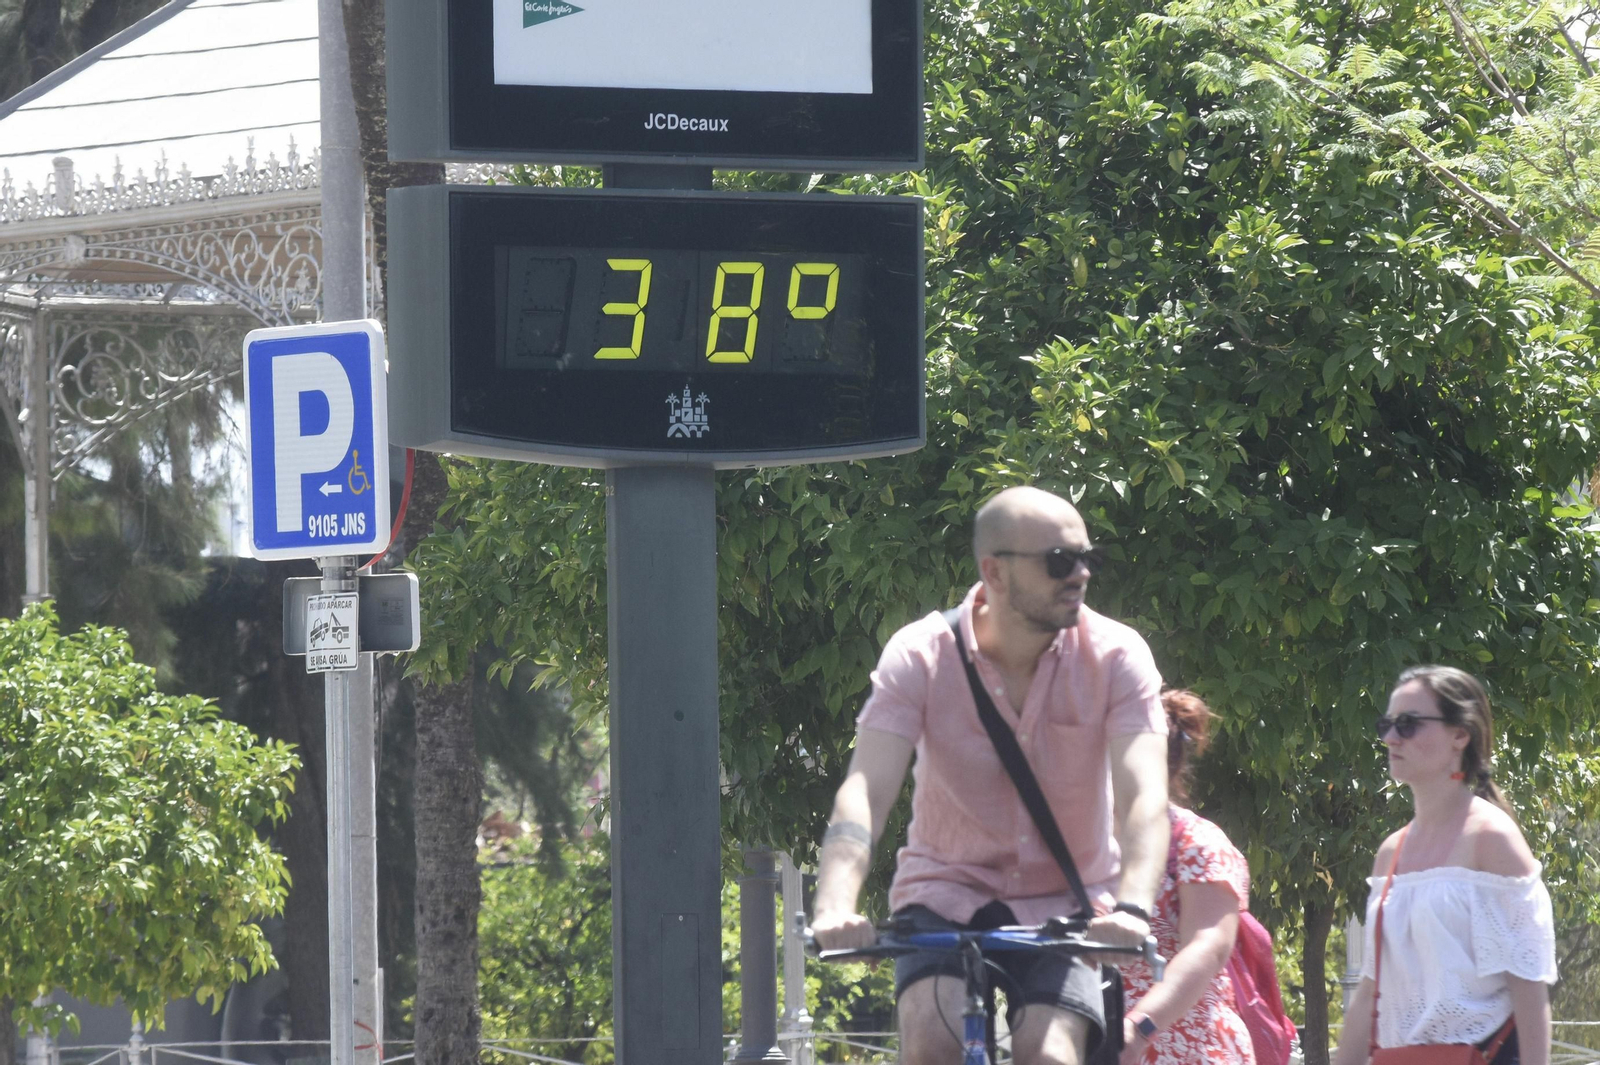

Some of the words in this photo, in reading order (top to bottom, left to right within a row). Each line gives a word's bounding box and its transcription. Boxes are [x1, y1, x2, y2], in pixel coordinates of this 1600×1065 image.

[525, 2, 531, 11] El
[532, 2, 548, 12] Corte
[548, 1, 572, 15] Inglés
[644, 113, 729, 132] JCDecaux
[271, 351, 354, 533] P
[308, 515, 338, 538] 9105
[341, 512, 366, 536] JNS
[327, 600, 352, 609] APARCAR
[310, 656, 315, 666] SE
[329, 652, 347, 665] GRÚA
